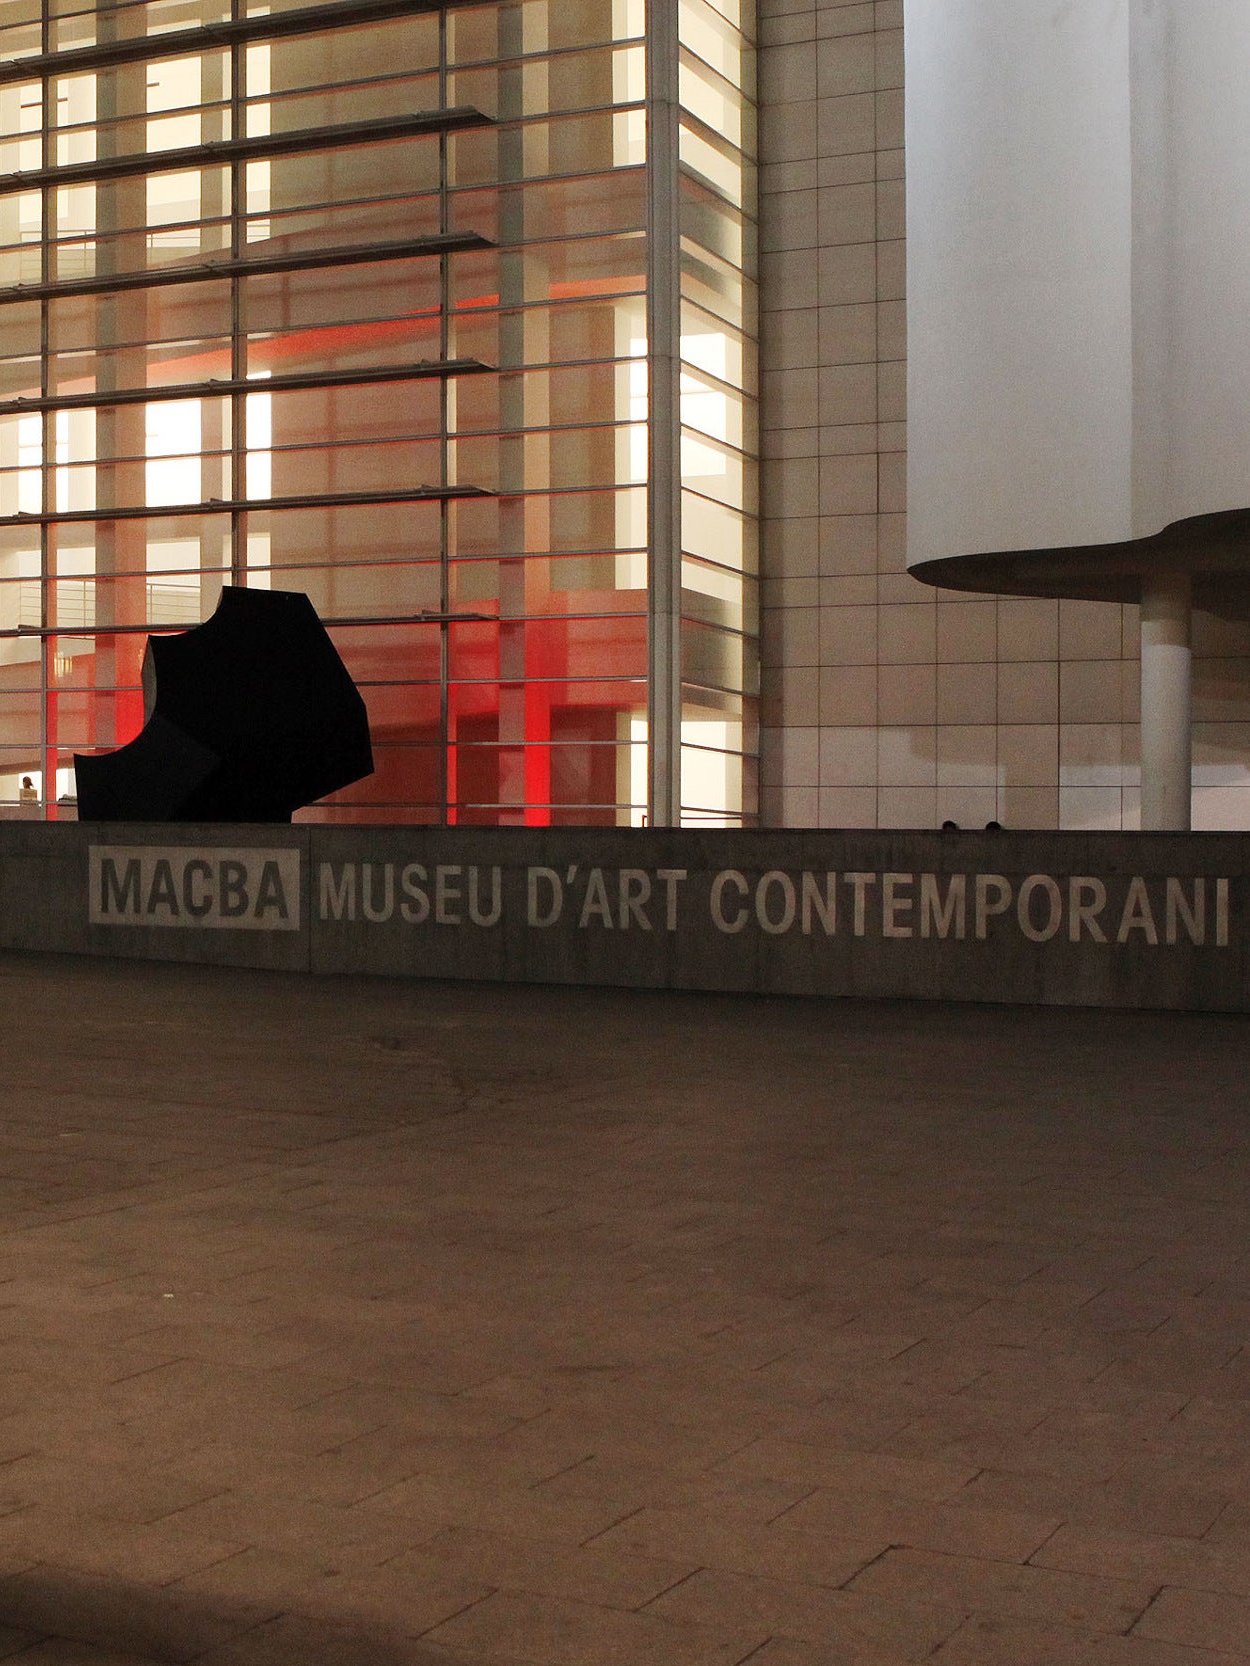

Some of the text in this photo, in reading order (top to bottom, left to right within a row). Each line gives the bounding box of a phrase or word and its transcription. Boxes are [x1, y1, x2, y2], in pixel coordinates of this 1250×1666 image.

[100, 858, 1229, 946] MACBA MUSEU D'ART CONTEMPORANI
